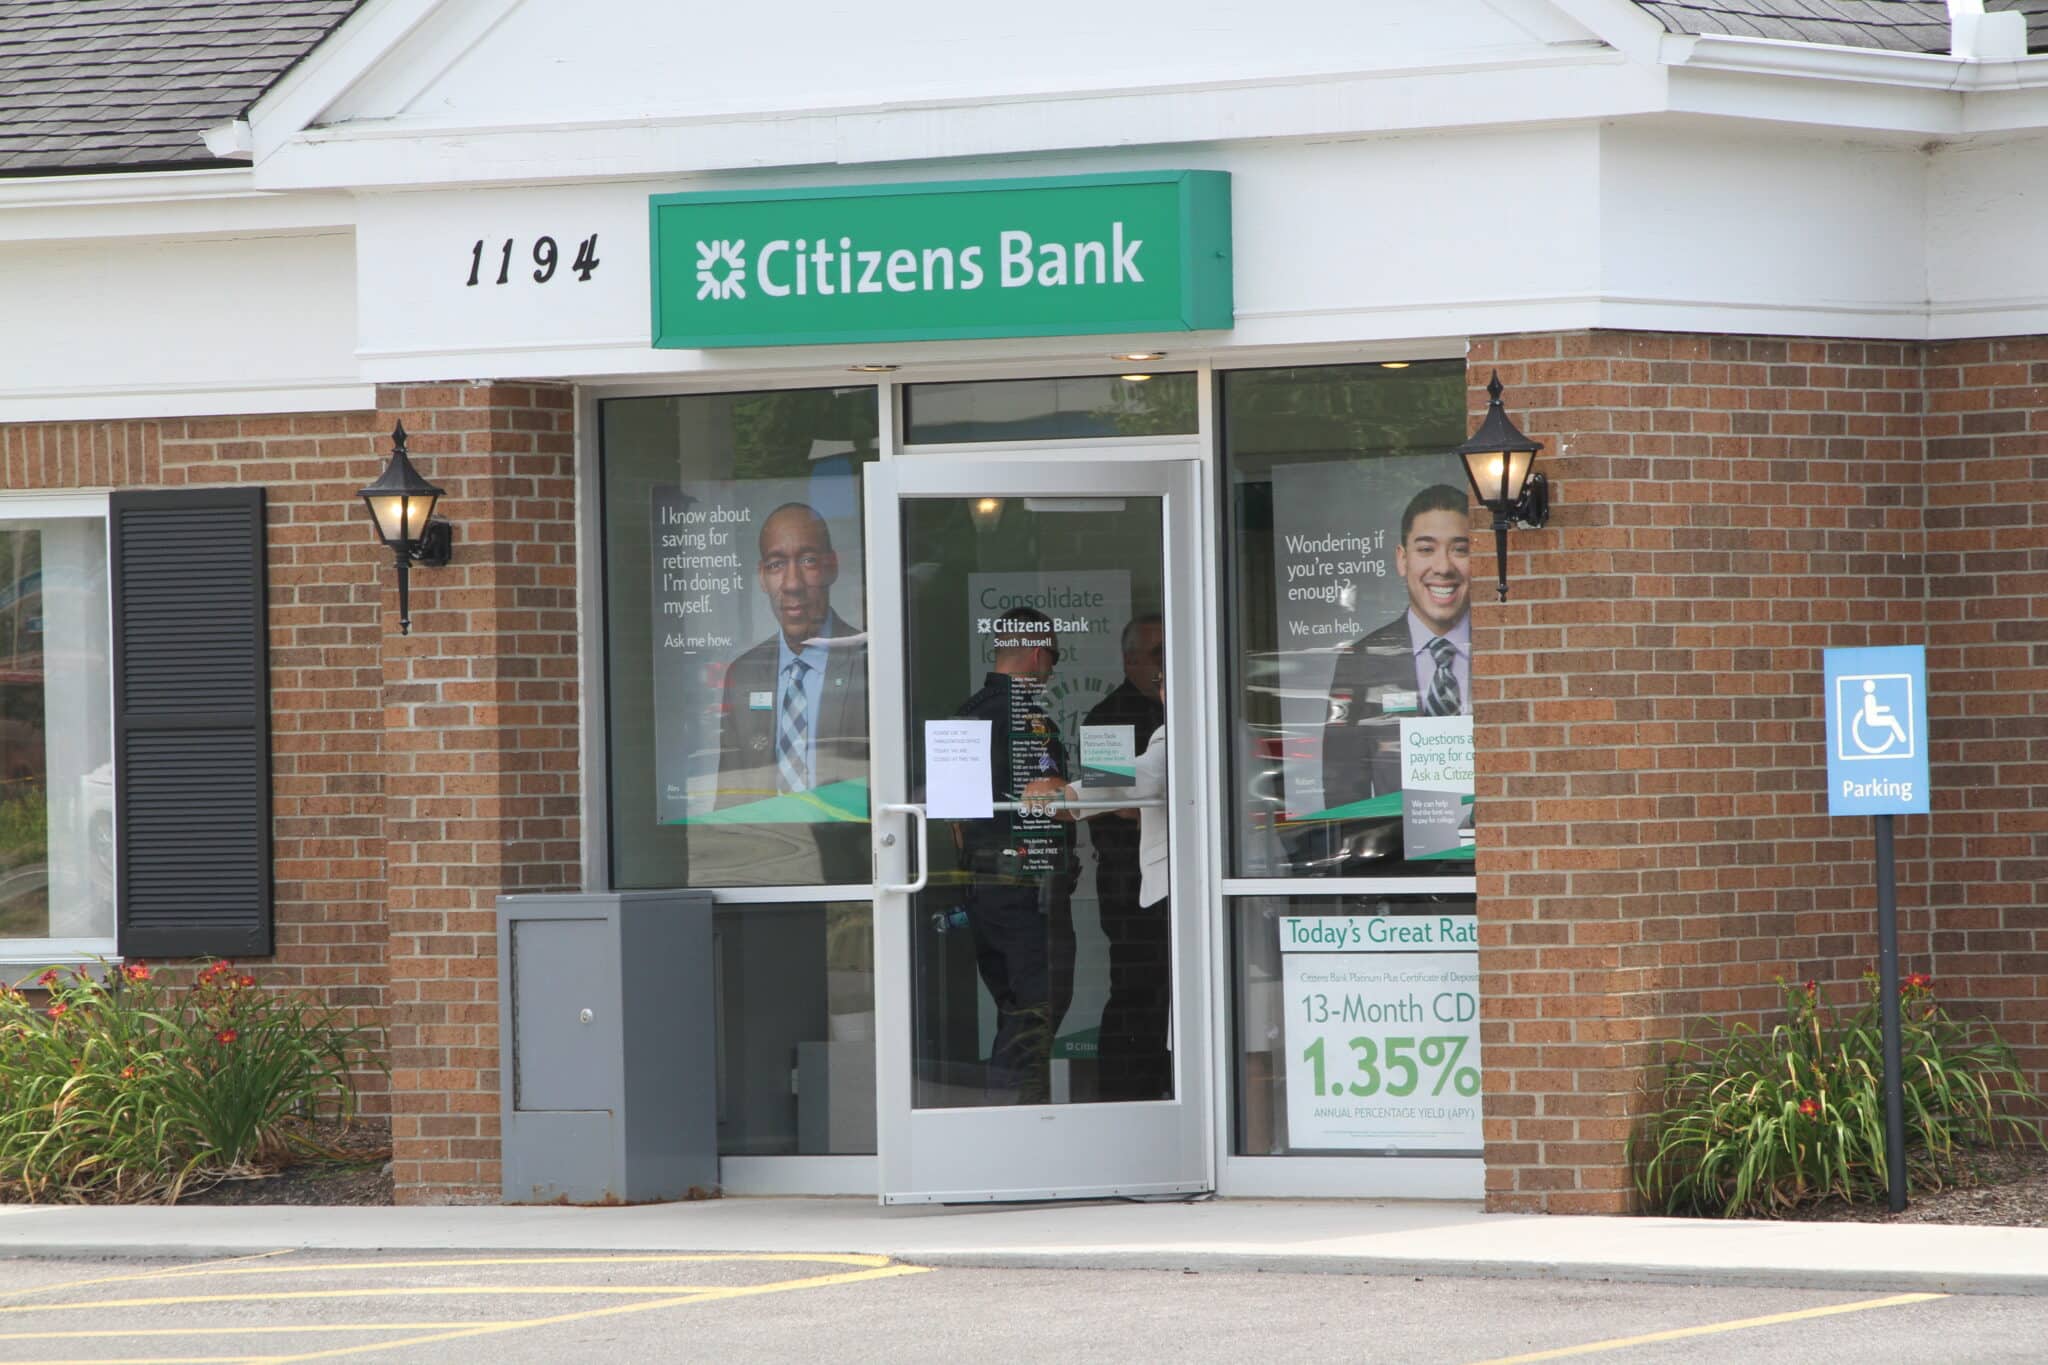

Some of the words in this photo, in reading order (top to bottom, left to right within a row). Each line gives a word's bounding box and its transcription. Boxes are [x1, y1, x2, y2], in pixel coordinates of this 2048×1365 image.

[466, 233, 600, 286] 1194
[757, 237, 984, 297] Citizens
[1000, 222, 1144, 288] Bank
[661, 506, 666, 525] I
[669, 506, 706, 525] know
[709, 505, 751, 523] about
[661, 529, 706, 550] saving
[709, 527, 729, 546] for
[1285, 532, 1371, 554] Wondering
[1374, 530, 1385, 549] if
[662, 551, 742, 570] retirement.
[1287, 557, 1335, 583] you're
[1337, 554, 1386, 577] saving
[663, 573, 687, 593] I'm
[690, 571, 730, 594] doing
[733, 572, 744, 590] it
[663, 595, 713, 619] myself.
[980, 585, 1104, 610] Consolidate
[992, 617, 1051, 634] Citizens
[1053, 616, 1089, 633] Bank
[1289, 620, 1309, 636] We
[1312, 623, 1332, 635] can
[1334, 617, 1364, 636] help.
[663, 633, 685, 648] Ask
[687, 637, 705, 648] me
[707, 632, 732, 648] how.
[993, 637, 1020, 648] South
[1021, 636, 1052, 648] Russell
[1409, 731, 1465, 748] Questions
[1410, 751, 1446, 766] paying
[1448, 747, 1462, 761] for
[1411, 768, 1431, 782] Ask
[1433, 771, 1441, 781] a
[1842, 778, 1913, 802] Parking
[1287, 919, 1361, 949] Today's
[1368, 918, 1433, 943] Great
[1302, 993, 1424, 1023] 13-Month
[1433, 992, 1476, 1022] CD
[1303, 1035, 1481, 1097] 1.35%
[1313, 1108, 1352, 1118] ANNUAL
[1355, 1107, 1416, 1118] PERCENTAGE
[1419, 1107, 1445, 1119] YIELD
[1448, 1108, 1475, 1120] (APY)
